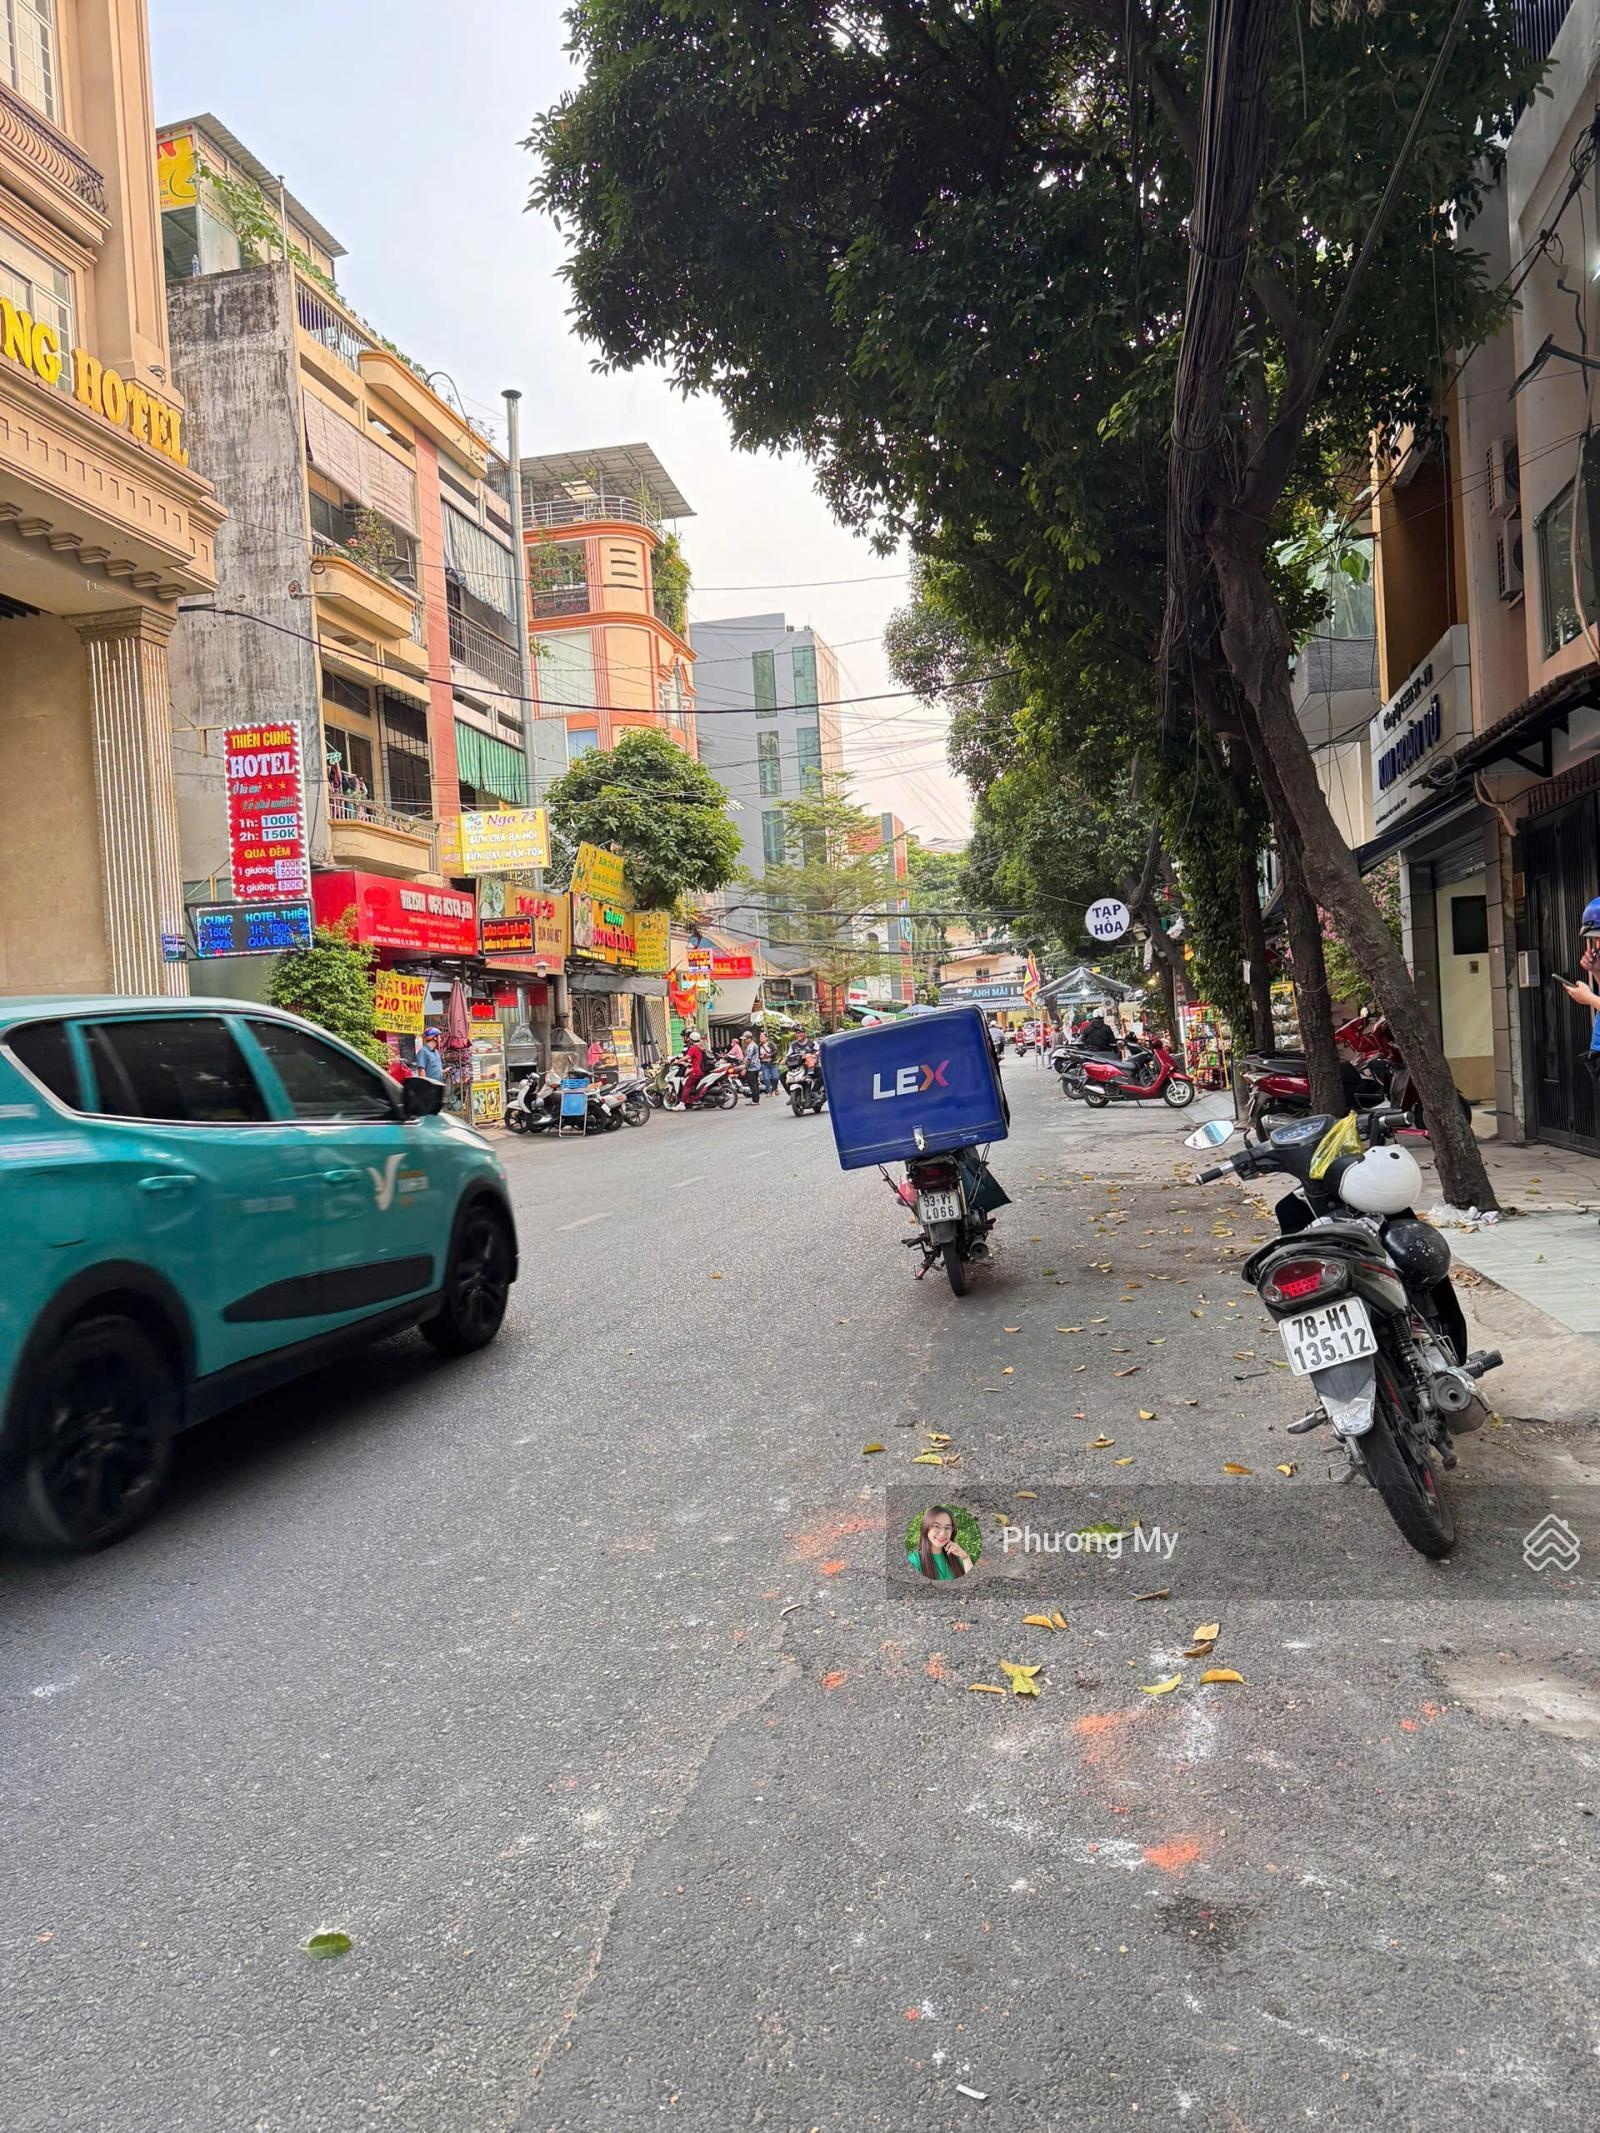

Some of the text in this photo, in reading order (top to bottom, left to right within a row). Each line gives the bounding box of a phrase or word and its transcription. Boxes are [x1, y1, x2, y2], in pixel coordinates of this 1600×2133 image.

[72, 347, 189, 467] HOTEL
[231, 730, 291, 749] THIÊN CUNG
[229, 752, 295, 778] HOTEL
[239, 815, 294, 828] 1h: 100K
[521, 810, 537, 822] 73
[240, 829, 296, 842] 2h: 150K
[244, 845, 291, 859] QUA ĐÊM
[240, 884, 245, 892] 2
[204, 915, 233, 926] CUNG
[245, 911, 279, 922] HOTEL
[1092, 904, 1122, 920] TẠP
[1094, 919, 1124, 935] HÓA
[972, 989, 990, 998] ANH
[376, 995, 400, 1011] CHO
[873, 1060, 950, 1100] LEX
[926, 1206, 955, 1220] 4066
[1292, 1305, 1353, 1342] 78-H1
[1294, 1328, 1371, 1369] 135.12
